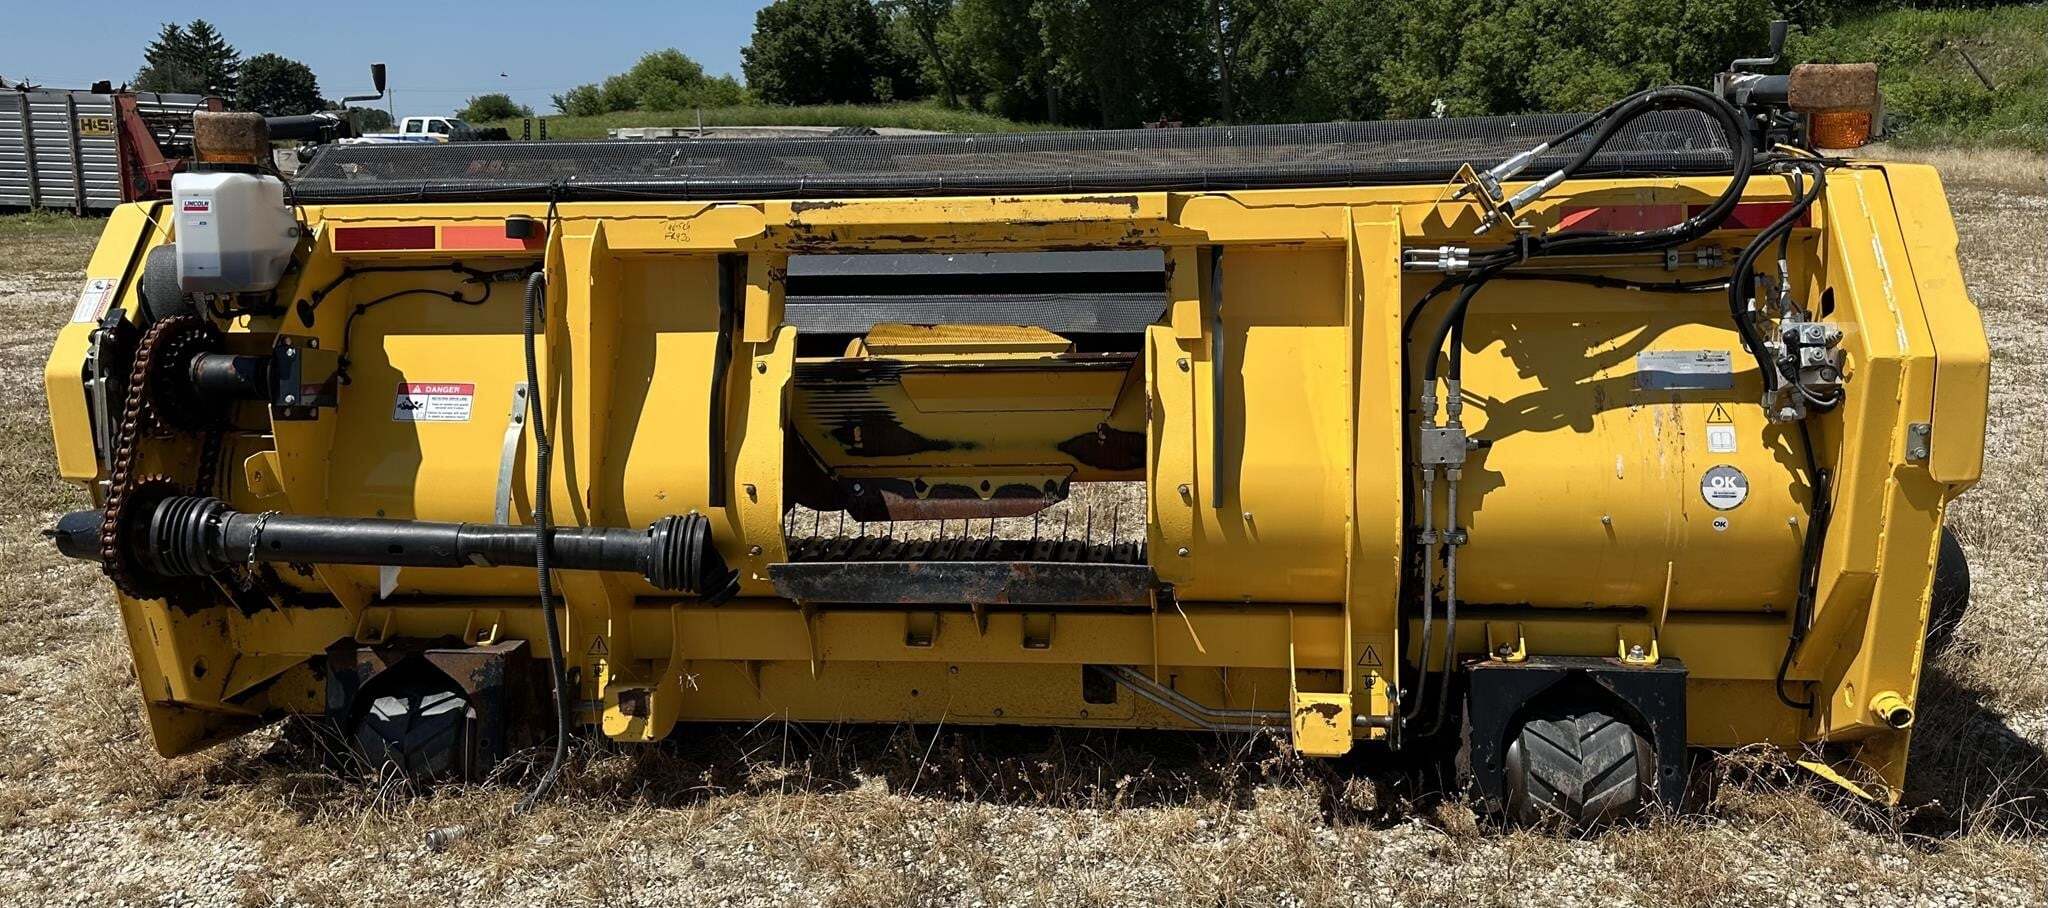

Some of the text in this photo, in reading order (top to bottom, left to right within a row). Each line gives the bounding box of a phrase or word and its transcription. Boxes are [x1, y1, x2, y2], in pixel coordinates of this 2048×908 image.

[80, 118, 110, 131] H&S
[425, 385, 460, 394] DANGER
[1711, 475, 1738, 489] OK
[1713, 520, 1727, 528] OK
